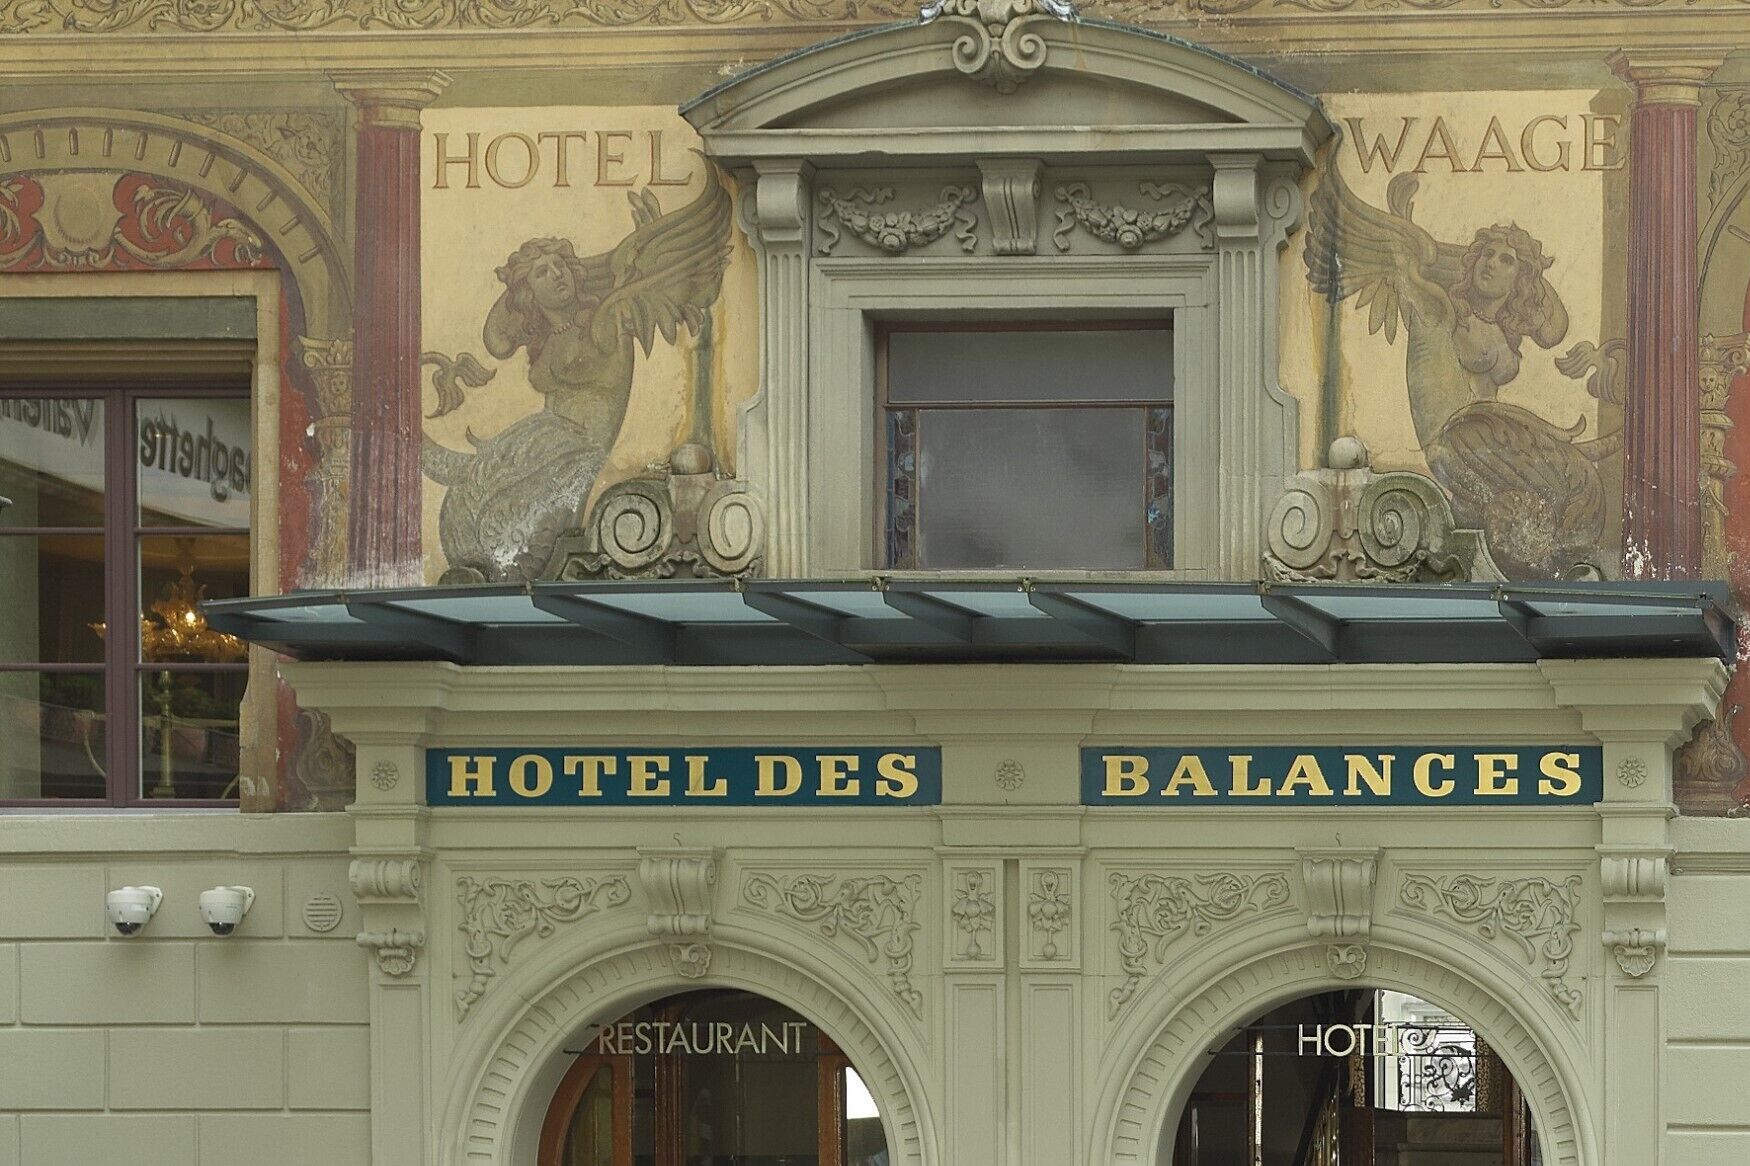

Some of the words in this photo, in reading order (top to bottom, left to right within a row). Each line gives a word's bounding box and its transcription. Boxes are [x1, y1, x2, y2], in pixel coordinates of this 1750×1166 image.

[432, 129, 694, 189] HOTEL
[1343, 113, 1627, 174] WAAGE
[447, 753, 728, 798] HOTEL
[754, 753, 920, 799] DES
[1101, 752, 1583, 798] BALANCES
[598, 1021, 807, 1055] RESTAURANT
[1297, 1023, 1405, 1058] HOTEL
